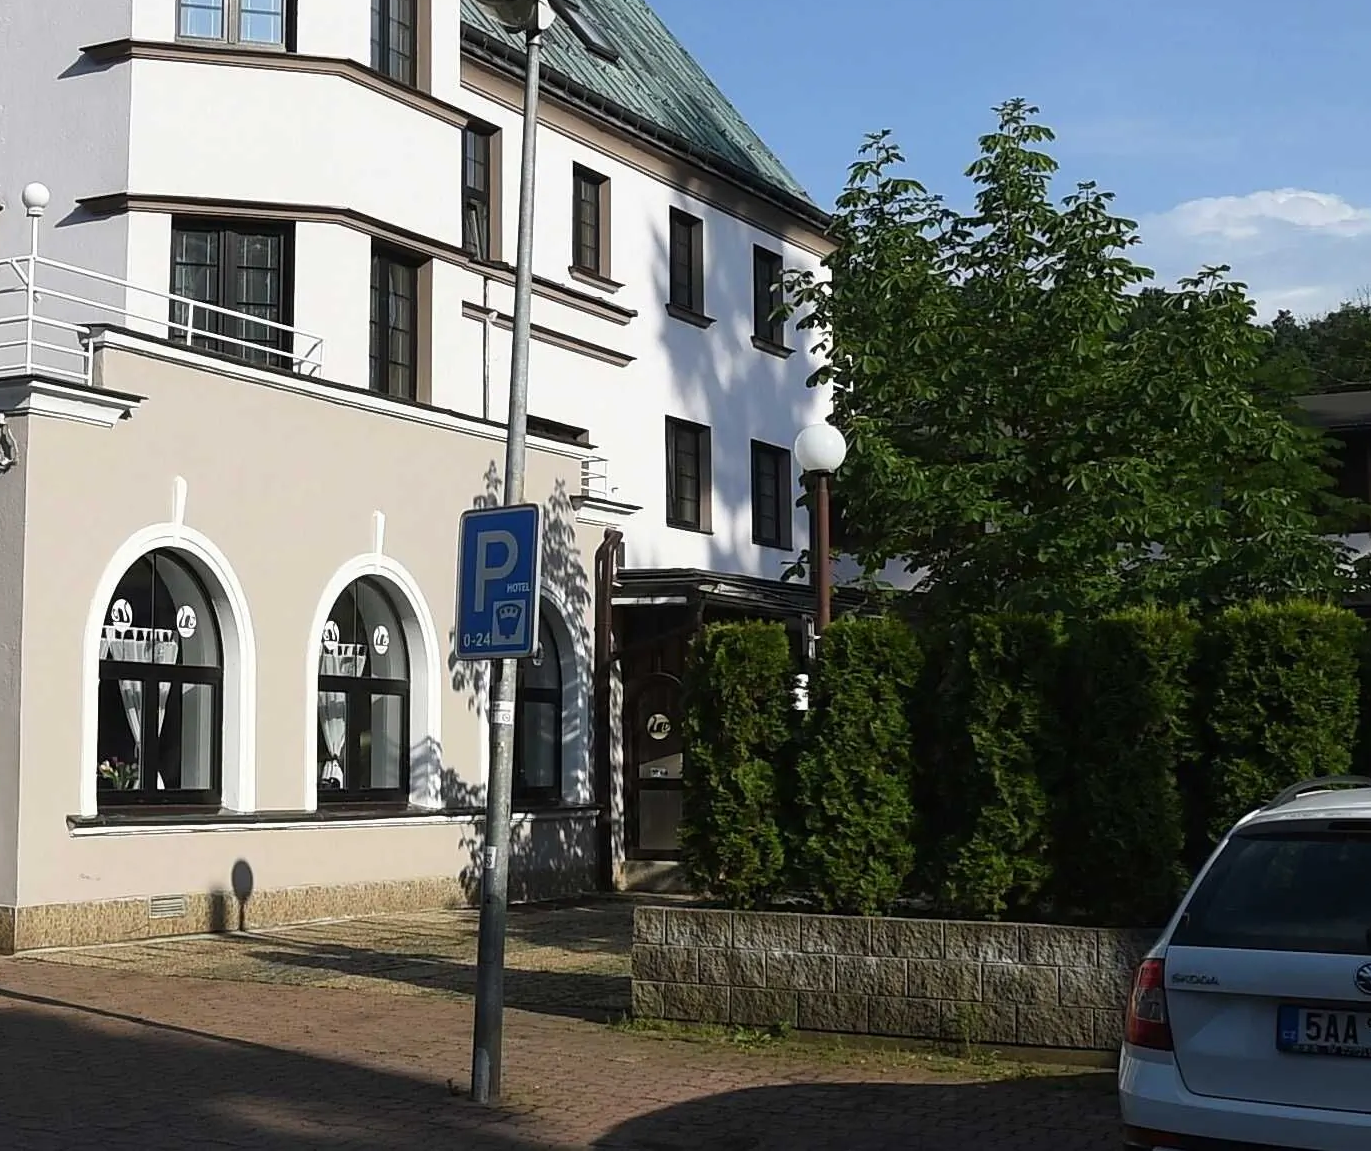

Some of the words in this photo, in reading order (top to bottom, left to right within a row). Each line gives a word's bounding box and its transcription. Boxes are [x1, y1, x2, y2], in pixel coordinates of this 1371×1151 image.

[474, 530, 518, 612] P
[506, 582, 530, 594] HOTEL
[463, 632, 491, 648] 0-24
[1305, 1012, 1359, 1045] 5AA
